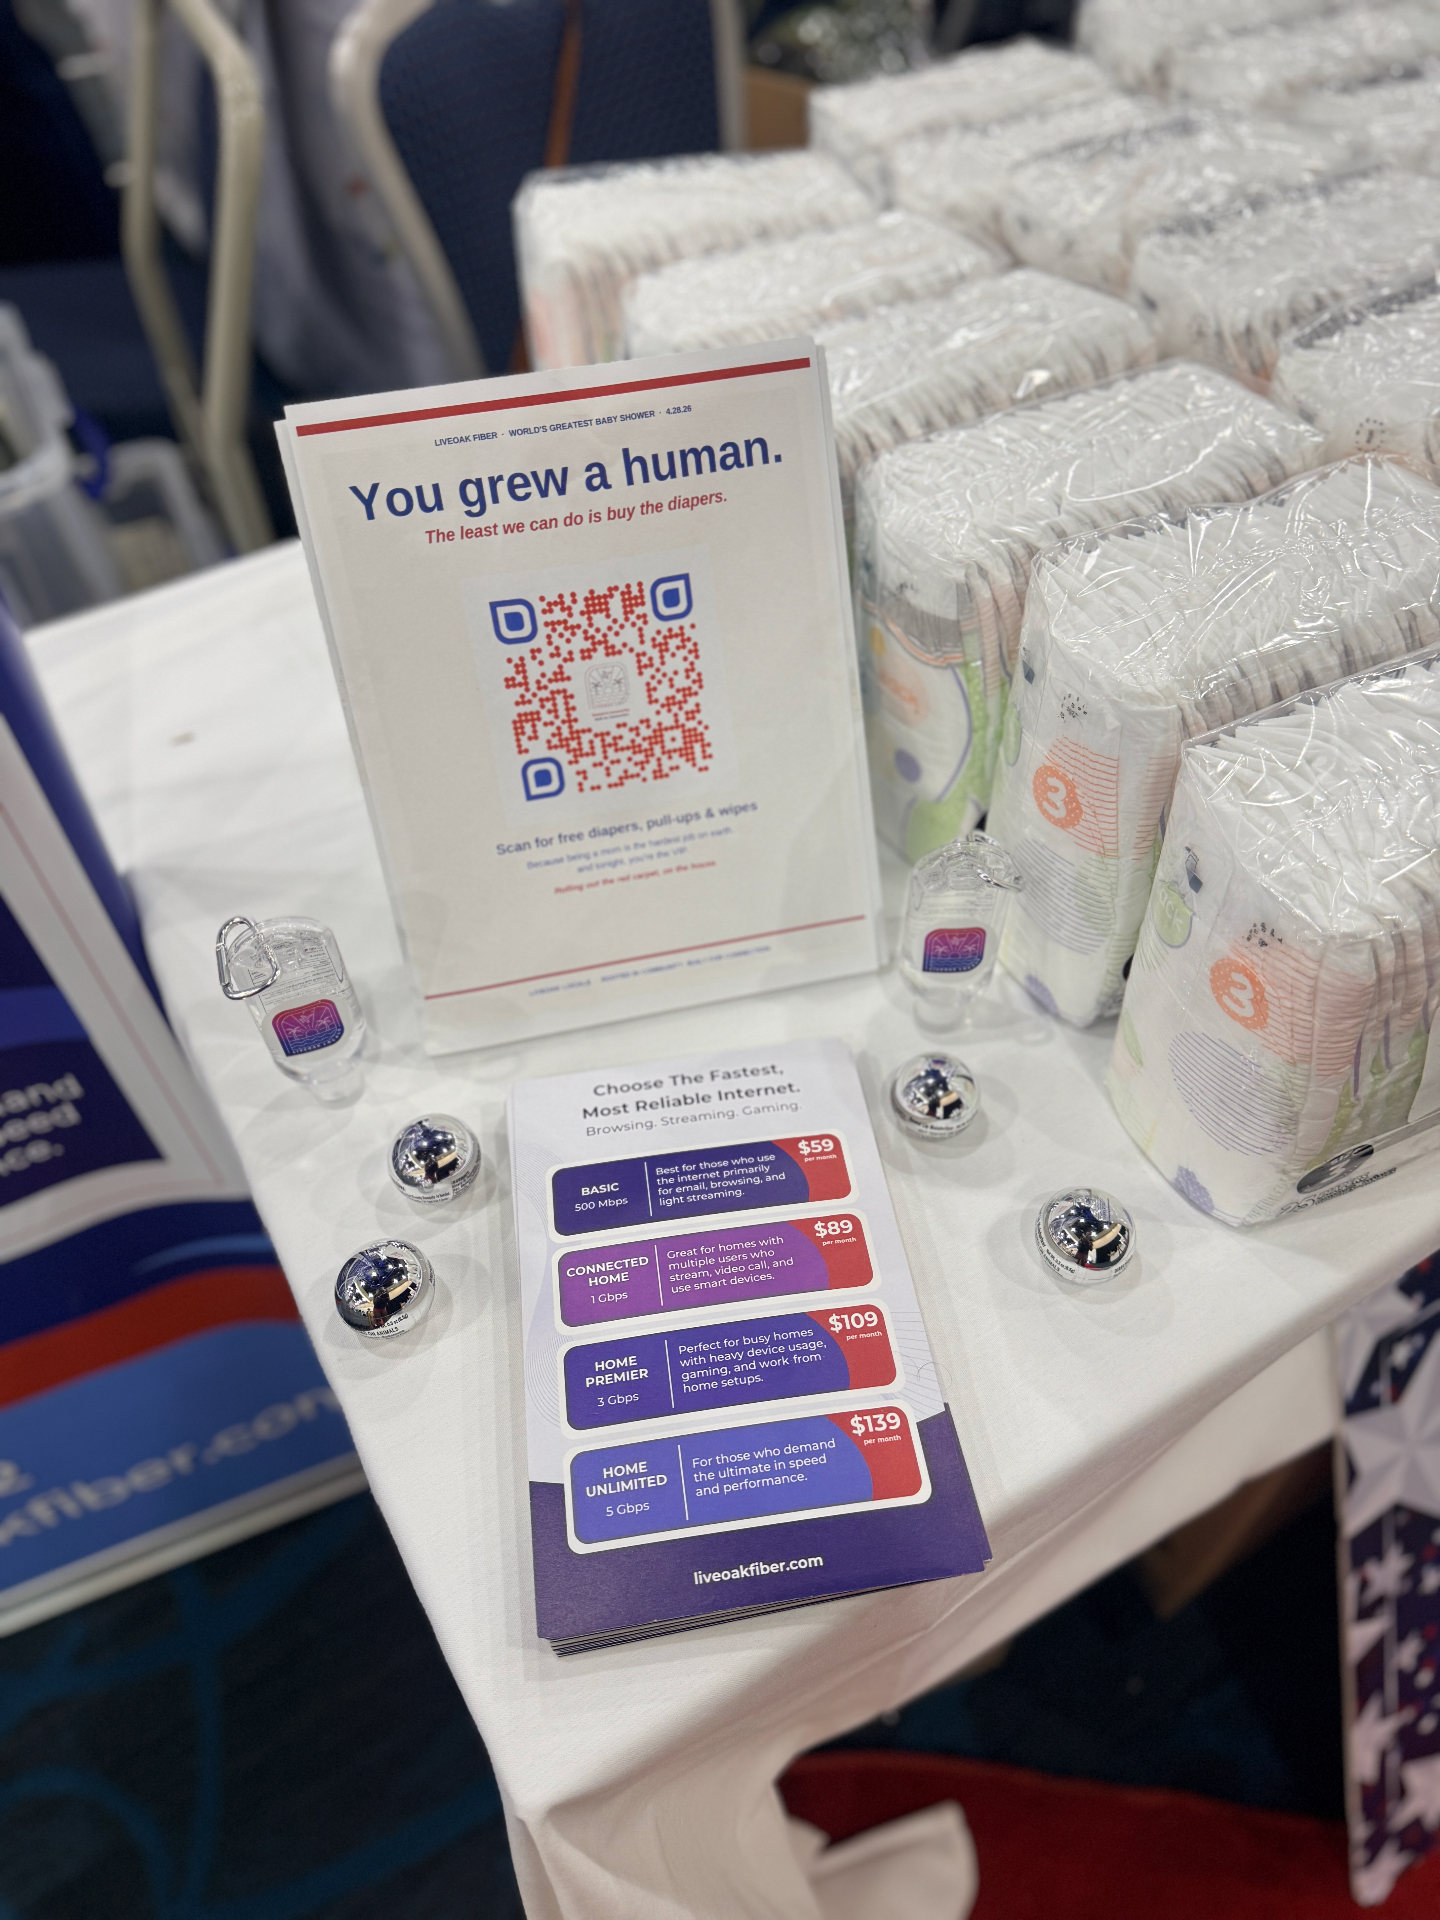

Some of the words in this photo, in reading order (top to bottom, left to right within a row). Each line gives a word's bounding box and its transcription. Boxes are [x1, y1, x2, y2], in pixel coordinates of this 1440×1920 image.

[434, 435, 471, 446] LIVEOAK
[472, 431, 498, 441] FIBER
[508, 425, 547, 436] WORLD'S
[549, 419, 593, 432] GREATEST
[595, 415, 618, 425] BABY
[619, 410, 655, 422] SHOWER
[665, 404, 692, 415] 4.28.26
[348, 482, 444, 520] You
[458, 466, 568, 518] grew
[584, 461, 612, 492] a
[622, 437, 782, 486] human.
[425, 528, 455, 544] The
[460, 523, 498, 540] least
[502, 522, 525, 535] we
[529, 517, 558, 531] can
[563, 512, 583, 527] do
[588, 509, 602, 523] is
[607, 506, 635, 521] buy
[640, 500, 663, 515] the
[667, 492, 727, 511] diapers.
[1043, 777, 1067, 819] 3
[496, 841, 532, 856] Scan
[535, 836, 554, 849] for
[558, 832, 584, 844] free
[588, 822, 642, 838] diapers,
[646, 812, 701, 830] pull-ups
[705, 808, 714, 818] &
[718, 802, 758, 816] wipes
[1221, 971, 1255, 1018] 3
[593, 1080, 663, 1096] Choose
[669, 1074, 704, 1086] The
[709, 1064, 783, 1081] Fastest,
[0, 1072, 84, 1117] and
[583, 1103, 628, 1119] Most
[635, 1093, 711, 1112] Reliable
[718, 1083, 800, 1101] Internet.
[0, 1100, 81, 1147] eed
[586, 1120, 657, 1137] Browsing.
[660, 1110, 738, 1126] Streaming.
[741, 1102, 802, 1116] Gaming.
[798, 1139, 834, 1155] $59
[655, 1165, 680, 1175] Best
[681, 1163, 696, 1171] for
[699, 1160, 729, 1169] those
[730, 1156, 755, 1165] who
[757, 1154, 776, 1162] use
[656, 1177, 675, 1185] the
[677, 1170, 720, 1183] internet
[723, 1164, 770, 1178] primarily
[581, 1182, 619, 1196] BASIC
[657, 1187, 672, 1195] for
[675, 1181, 708, 1193] email,
[710, 1176, 763, 1189] browsing,
[765, 1171, 786, 1182] and
[574, 1201, 596, 1212] 500
[598, 1197, 628, 1208] Mbps
[659, 1196, 684, 1207] light
[686, 1189, 745, 1202] streaming.
[814, 1219, 853, 1238] $89
[666, 1248, 697, 1259] Great
[700, 1245, 715, 1254] for
[718, 1240, 757, 1252] homes
[758, 1236, 784, 1246] with
[834, 1236, 857, 1244] month
[566, 1256, 649, 1277] CONNECTED
[668, 1256, 715, 1270] multiple
[718, 1253, 748, 1263] users
[749, 1249, 775, 1259] who
[669, 1270, 712, 1282] stream,
[714, 1265, 745, 1275] video
[747, 1260, 770, 1271] call,
[772, 1256, 794, 1268] and
[588, 1271, 629, 1286] HOME
[671, 1284, 691, 1293] use
[693, 1278, 727, 1290] smart
[729, 1273, 775, 1285] devices.
[590, 1295, 595, 1304] 1
[598, 1292, 628, 1303] Gbps
[828, 1311, 878, 1333] $109
[678, 1341, 721, 1355] Perfect
[723, 1338, 739, 1347] for
[742, 1334, 771, 1345] busy
[773, 1329, 814, 1341] homes
[859, 1330, 882, 1338] month
[594, 1355, 637, 1372] HOME
[679, 1355, 706, 1367] with
[709, 1351, 744, 1363] heavy
[747, 1345, 785, 1357] device
[788, 1340, 827, 1352] usage,
[585, 1368, 648, 1387] PREMIER
[681, 1366, 731, 1382] gaming,
[733, 1360, 757, 1373] and
[683, 1381, 718, 1393] home
[721, 1374, 763, 1387] setups.
[597, 1397, 604, 1407] 3
[607, 1393, 639, 1405] Gbps
[850, 1412, 901, 1436] $139
[863, 1438, 875, 1446] per
[877, 1434, 902, 1443] month
[692, 1457, 713, 1468] For
[715, 1452, 750, 1464] those
[752, 1447, 781, 1459] who
[783, 1437, 836, 1454] demand
[602, 1461, 647, 1478] HOME
[693, 1471, 715, 1482] the
[718, 1463, 771, 1479] ultimate
[773, 1459, 786, 1471] in
[788, 1453, 827, 1469] speed
[586, 1474, 667, 1497] UNLIMITED
[695, 1483, 720, 1497] and
[723, 1473, 808, 1495] performance.
[606, 1506, 614, 1517] 5
[616, 1502, 650, 1515] Gbps
[693, 1556, 823, 1585] liveoakfiber.com
